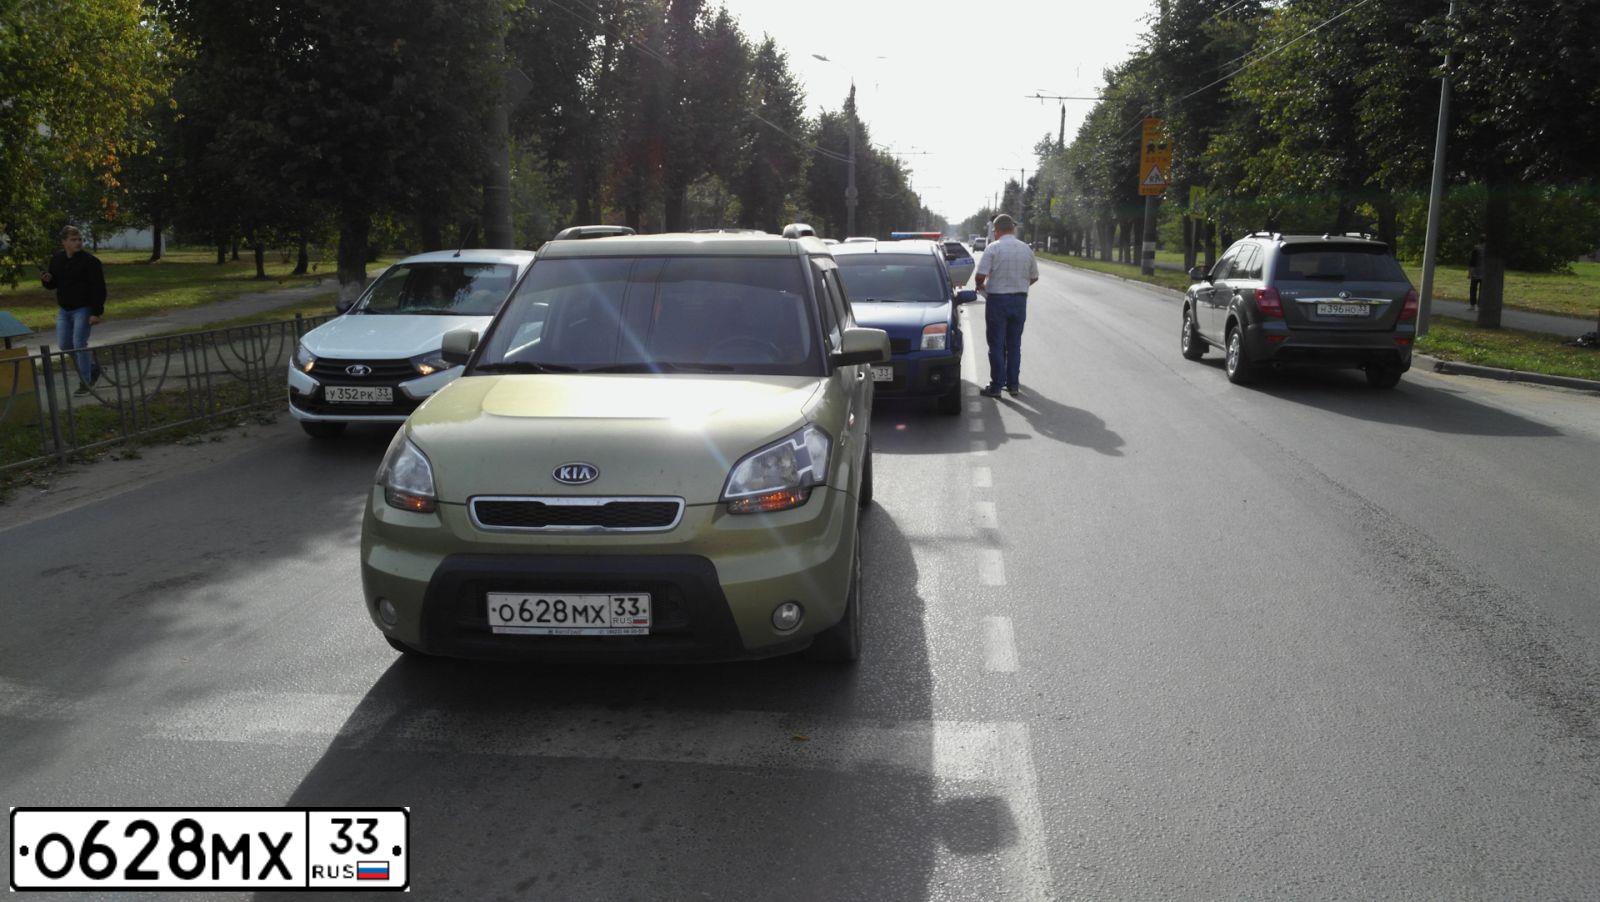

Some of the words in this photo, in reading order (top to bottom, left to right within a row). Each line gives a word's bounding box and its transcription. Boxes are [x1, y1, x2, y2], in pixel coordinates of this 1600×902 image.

[877, 367, 889, 377] 33
[330, 388, 374, 400] У352РК
[376, 387, 389, 397] 33
[560, 466, 591, 479] KIA
[499, 598, 606, 624] О628МХ
[613, 597, 641, 617] 33
[612, 617, 633, 625] RUS
